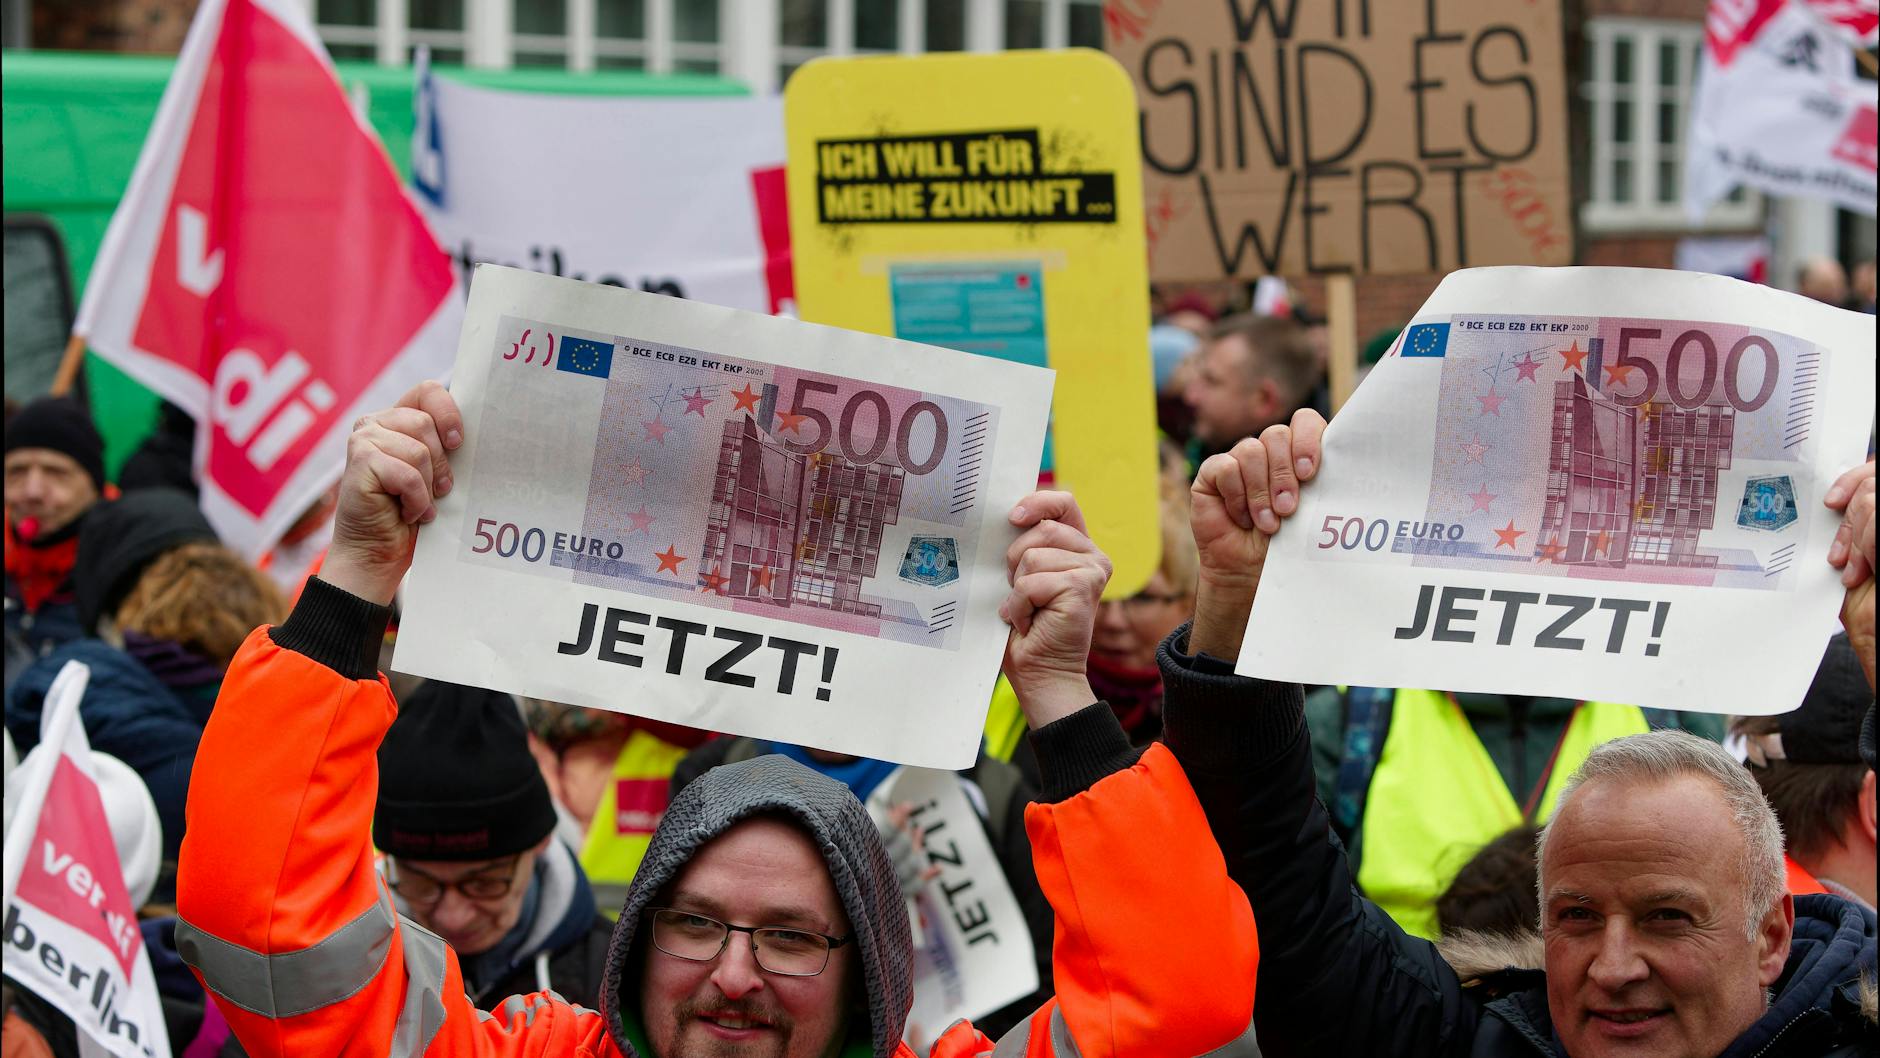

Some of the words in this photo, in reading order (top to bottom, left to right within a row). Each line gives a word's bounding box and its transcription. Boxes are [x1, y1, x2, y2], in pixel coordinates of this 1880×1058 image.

[1139, 36, 1374, 175] SIND
[1407, 23, 1540, 163] ES
[821, 143, 878, 178] ICH
[882, 140, 963, 177] WILL
[966, 134, 1035, 175] FÜR
[823, 183, 926, 219] MEINE
[1198, 159, 1499, 276] WERT
[1466, 321, 1484, 330] BCE
[1487, 322, 1505, 330] ECB
[1508, 322, 1526, 331] EZB
[1530, 323, 1548, 332] EKT
[1550, 324, 1569, 332] EKP
[632, 347, 652, 358] BCE
[655, 351, 675, 362] ECB
[678, 355, 698, 366] EZB
[701, 359, 722, 370] EKT
[723, 363, 743, 374] EKP
[1612, 327, 1780, 413] 500
[782, 378, 949, 476] 500
[1748, 493, 1785, 513] 500
[471, 517, 546, 563] 500
[552, 531, 624, 560] EURO
[1318, 515, 1390, 551] 500
[1395, 520, 1465, 541] EURO
[1394, 584, 1672, 657] JETZT!
[557, 602, 840, 702] JETZT!
